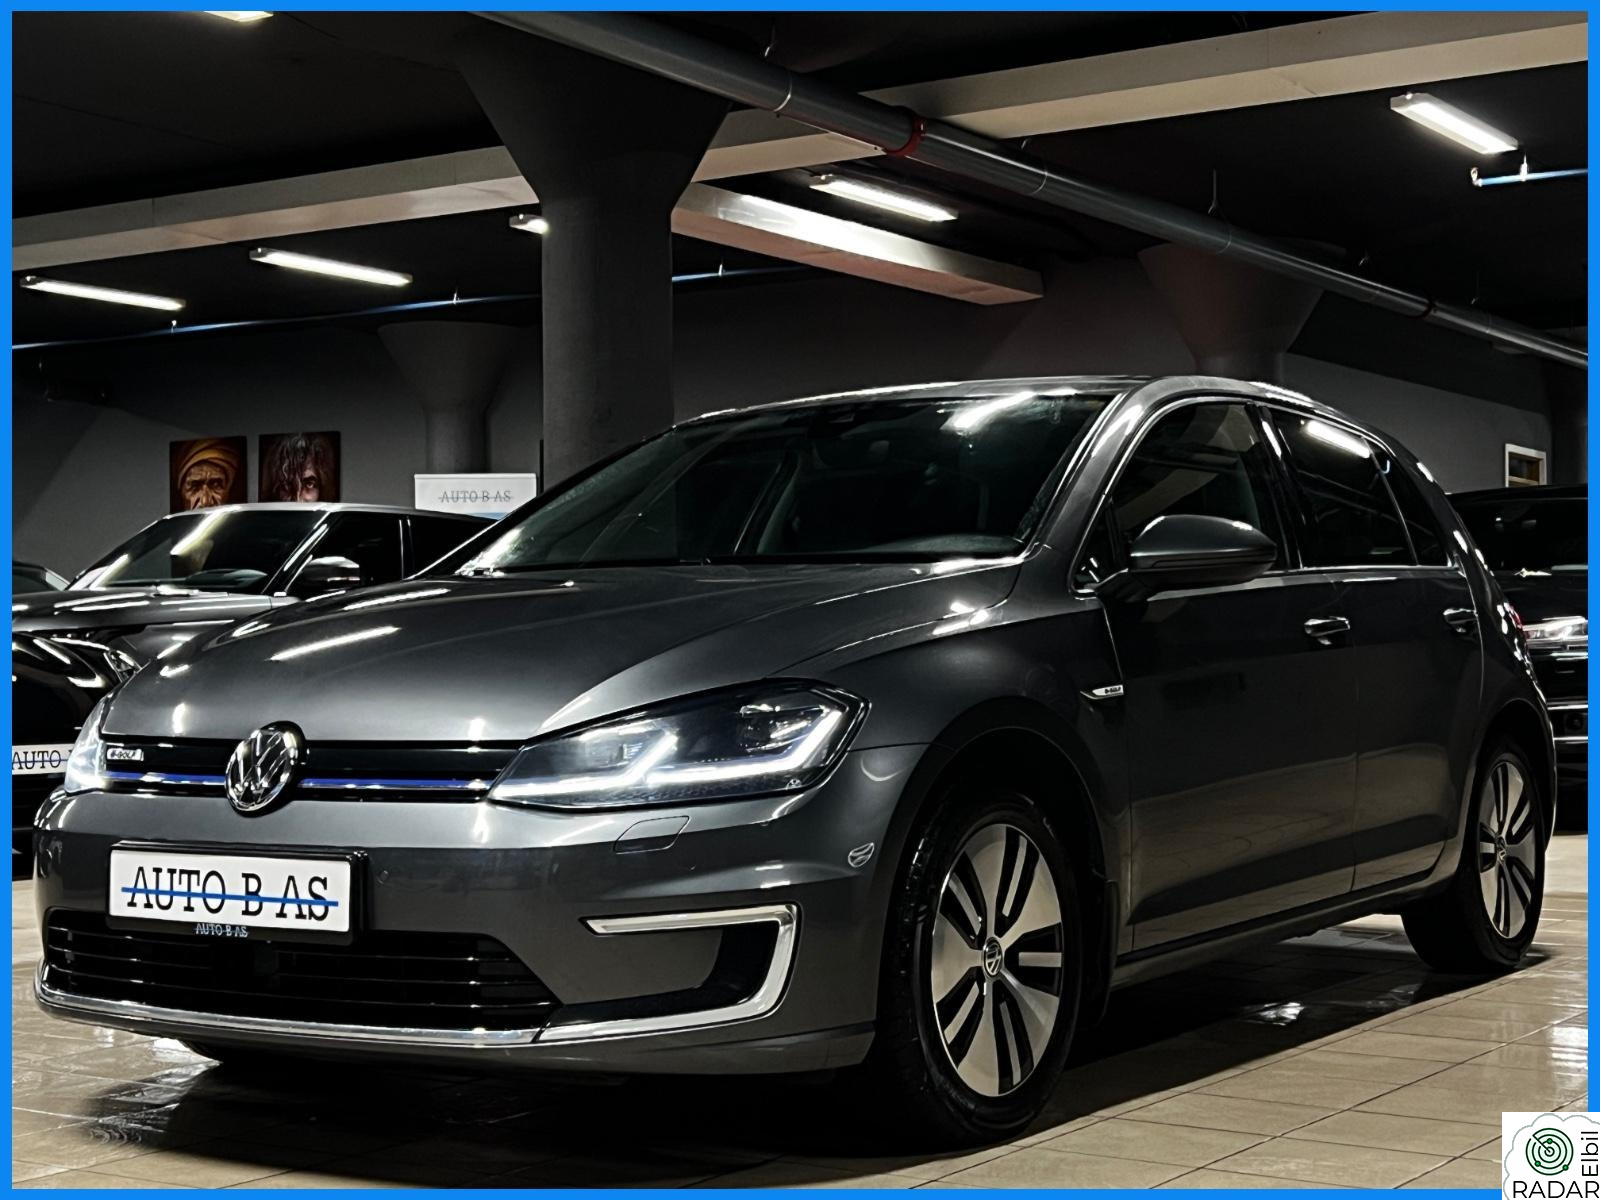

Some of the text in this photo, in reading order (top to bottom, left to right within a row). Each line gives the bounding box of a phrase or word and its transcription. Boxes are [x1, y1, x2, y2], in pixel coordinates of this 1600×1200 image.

[440, 490, 512, 503] AUTO B AS
[12, 750, 62, 770] AUTO
[126, 866, 330, 922] AUTO B AS
[195, 922, 249, 938] AUTO B AS
